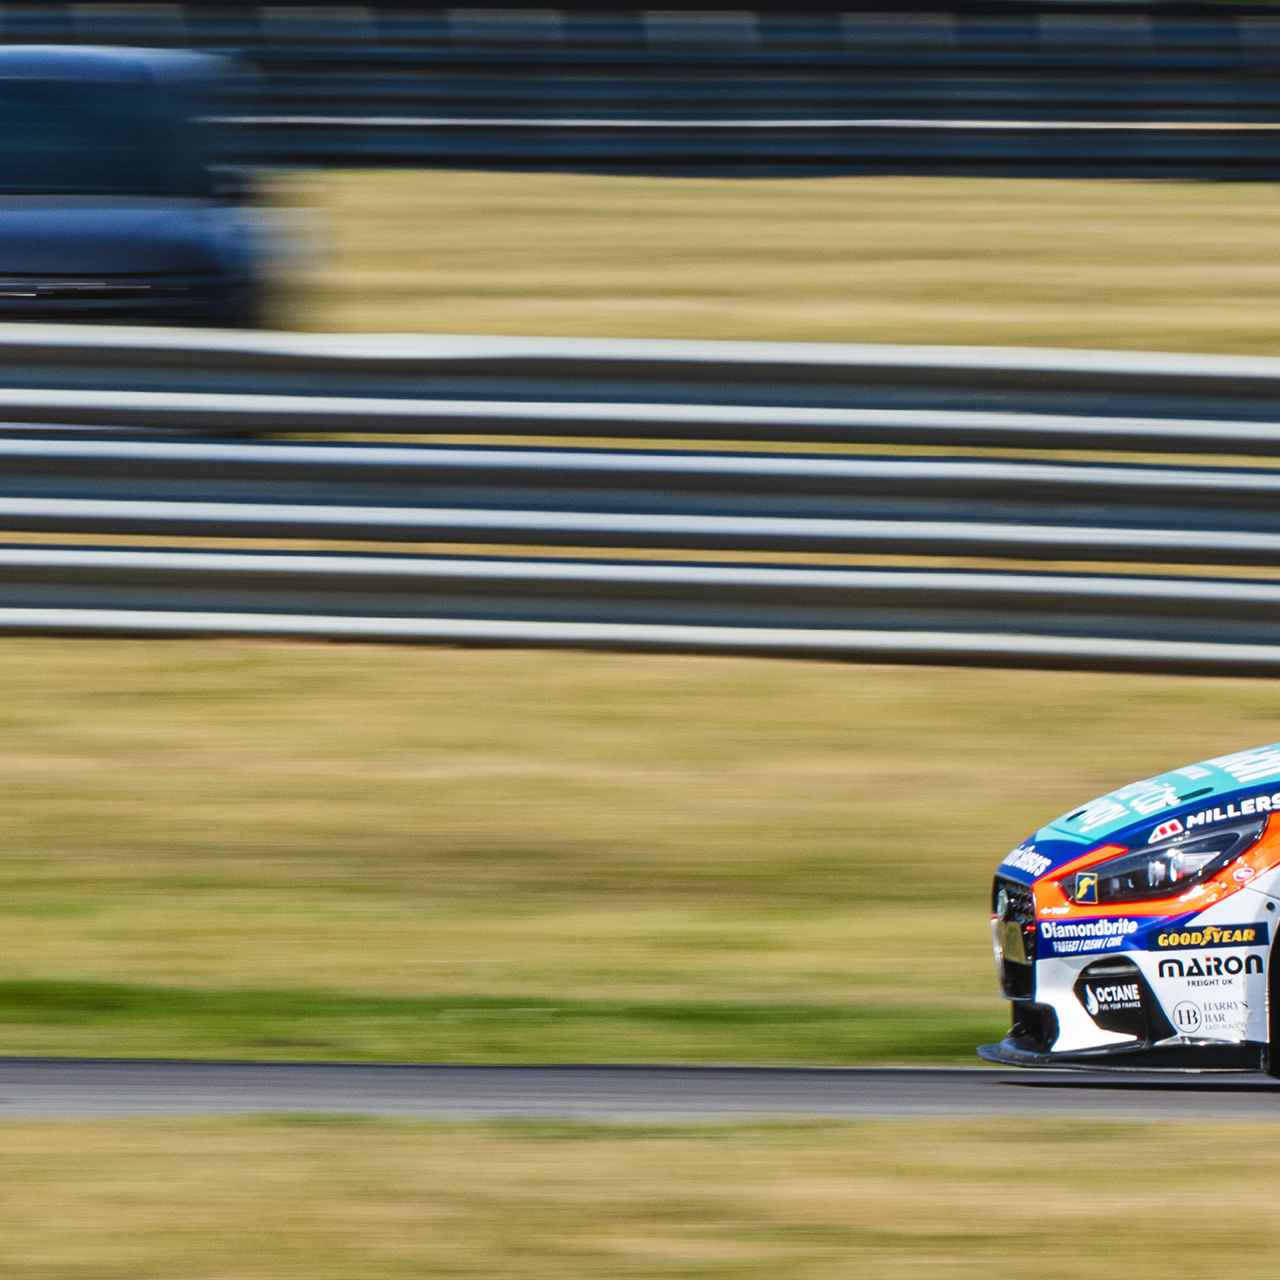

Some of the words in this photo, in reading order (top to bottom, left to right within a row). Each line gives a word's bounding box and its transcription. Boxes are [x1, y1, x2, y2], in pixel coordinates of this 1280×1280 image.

[1040, 918, 1138, 939] Diamondbrite
[1187, 979, 1220, 987] FREIGHT
[1222, 978, 1234, 986] UK
[1096, 984, 1140, 1002] OCTANE
[1204, 1013, 1226, 1023] BAR
